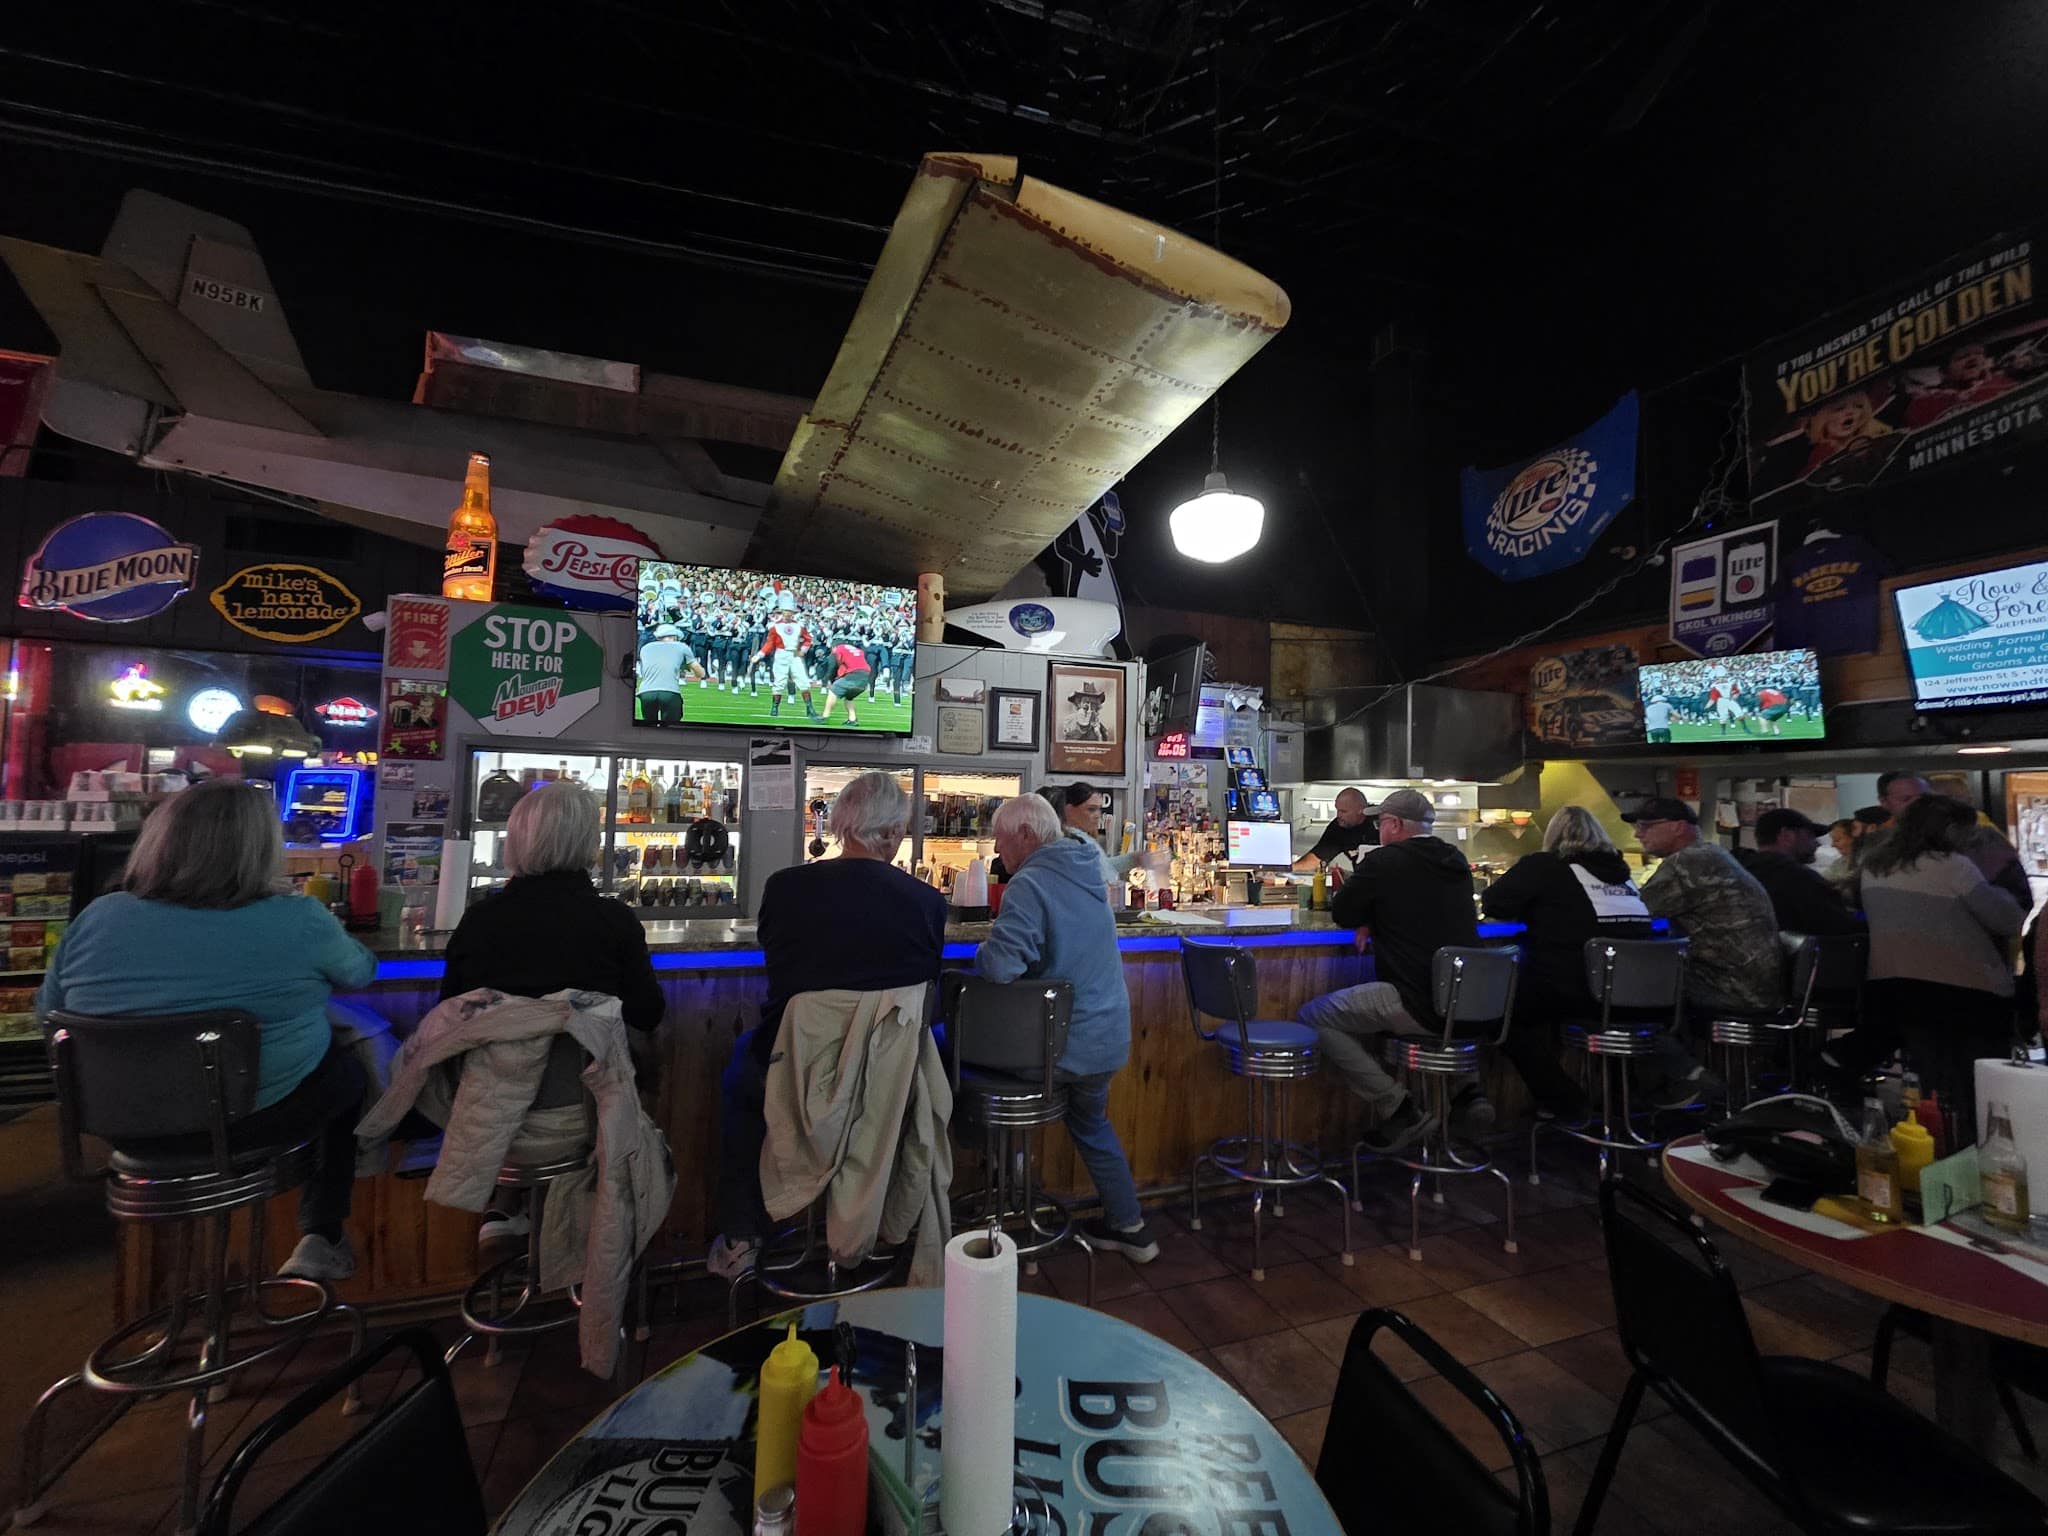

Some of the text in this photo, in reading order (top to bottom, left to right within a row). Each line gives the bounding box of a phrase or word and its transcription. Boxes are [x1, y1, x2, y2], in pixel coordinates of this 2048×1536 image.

[193, 280, 262, 312] N95BK
[1791, 351, 1813, 370] YOU
[1815, 326, 1867, 359] ANSWER
[1871, 308, 1896, 330] THE
[1897, 288, 1932, 316] CALL
[1934, 276, 1953, 297] OF
[1957, 260, 1985, 284] THE
[1988, 242, 2031, 269] WILD
[1776, 263, 2033, 414] YOU'RE GOLDEN
[1909, 404, 2043, 472] MINNESOTA
[1492, 498, 1591, 557] RACING
[1731, 556, 1764, 576] Lite
[31, 552, 189, 605] BLUE MOON
[242, 572, 319, 591] mike's
[261, 589, 326, 606] hard
[1956, 578, 2022, 605] Now
[232, 602, 346, 621] lemonade
[403, 611, 439, 625] FIRE
[1678, 608, 1767, 633] SKOL VIKINGS!
[483, 615, 577, 653] STOP
[1936, 632, 2045, 655] Wedding, Formal
[491, 652, 563, 673] HERE FOR
[1948, 651, 1992, 664] Mother
[1996, 647, 2010, 657] of
[2013, 644, 2035, 655] the
[1972, 658, 2022, 671] Grooms
[495, 674, 558, 703] Mountain
[1538, 667, 1562, 687] Lite
[1943, 673, 1993, 685] Jefferson
[1995, 670, 2007, 679] St
